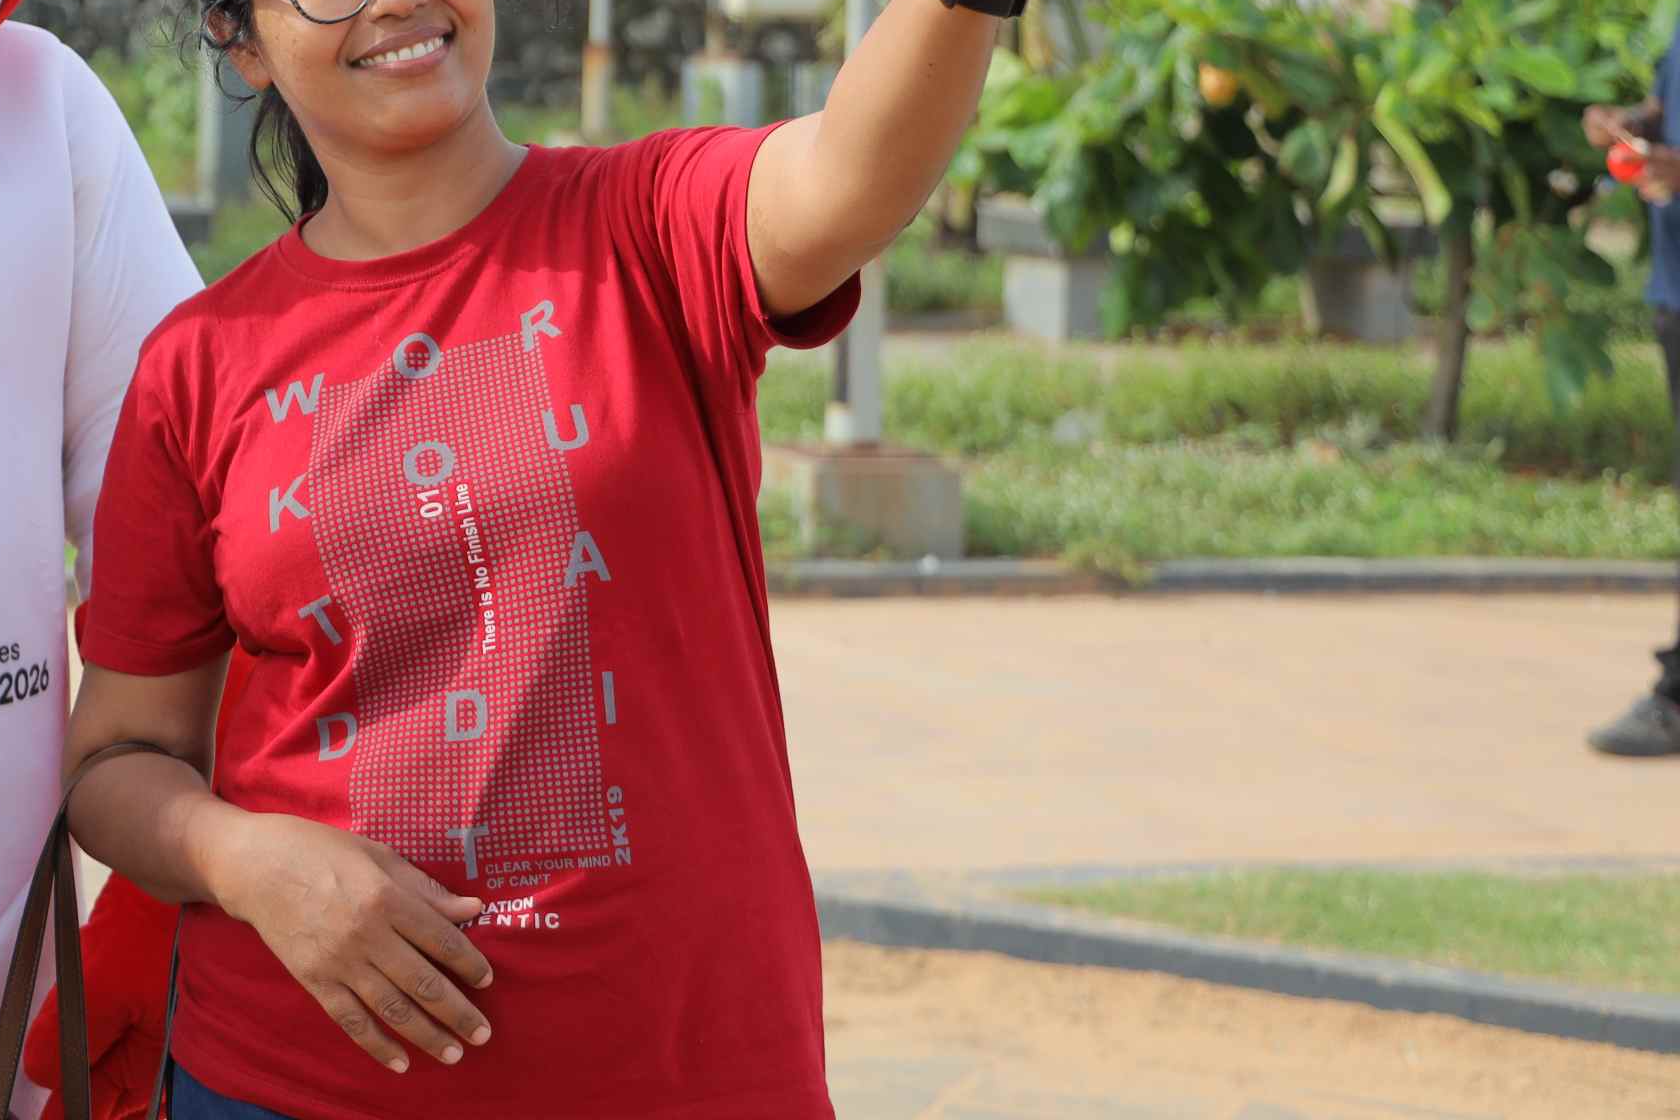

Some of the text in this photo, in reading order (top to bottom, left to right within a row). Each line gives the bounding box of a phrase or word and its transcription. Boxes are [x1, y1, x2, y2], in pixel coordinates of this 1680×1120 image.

[416, 489, 443, 518] 01
[455, 483, 496, 655] There is No Finish Line
[606, 784, 633, 866] 2K19
[485, 854, 612, 875] CLEAR YOUR MIND
[486, 873, 551, 890] OF CAN'T
